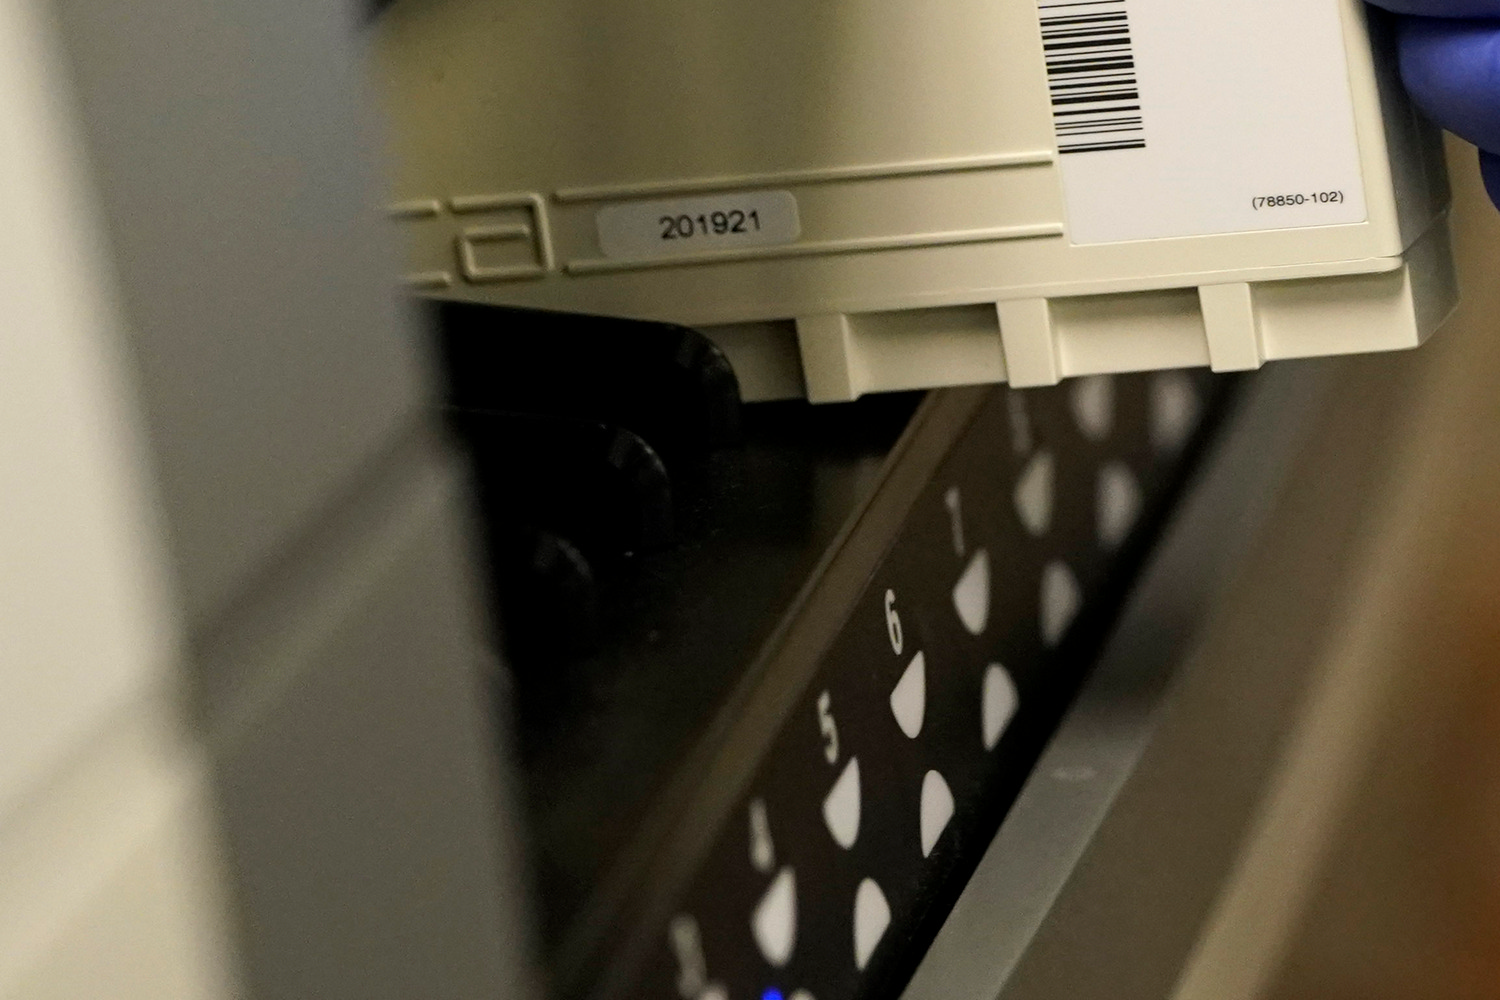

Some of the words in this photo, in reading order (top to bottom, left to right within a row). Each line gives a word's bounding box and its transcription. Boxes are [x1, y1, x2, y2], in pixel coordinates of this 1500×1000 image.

[1251, 190, 1344, 210] (78850-102)
[658, 209, 761, 240] 201921
[885, 589, 903, 655] 6
[817, 690, 839, 764] 5
